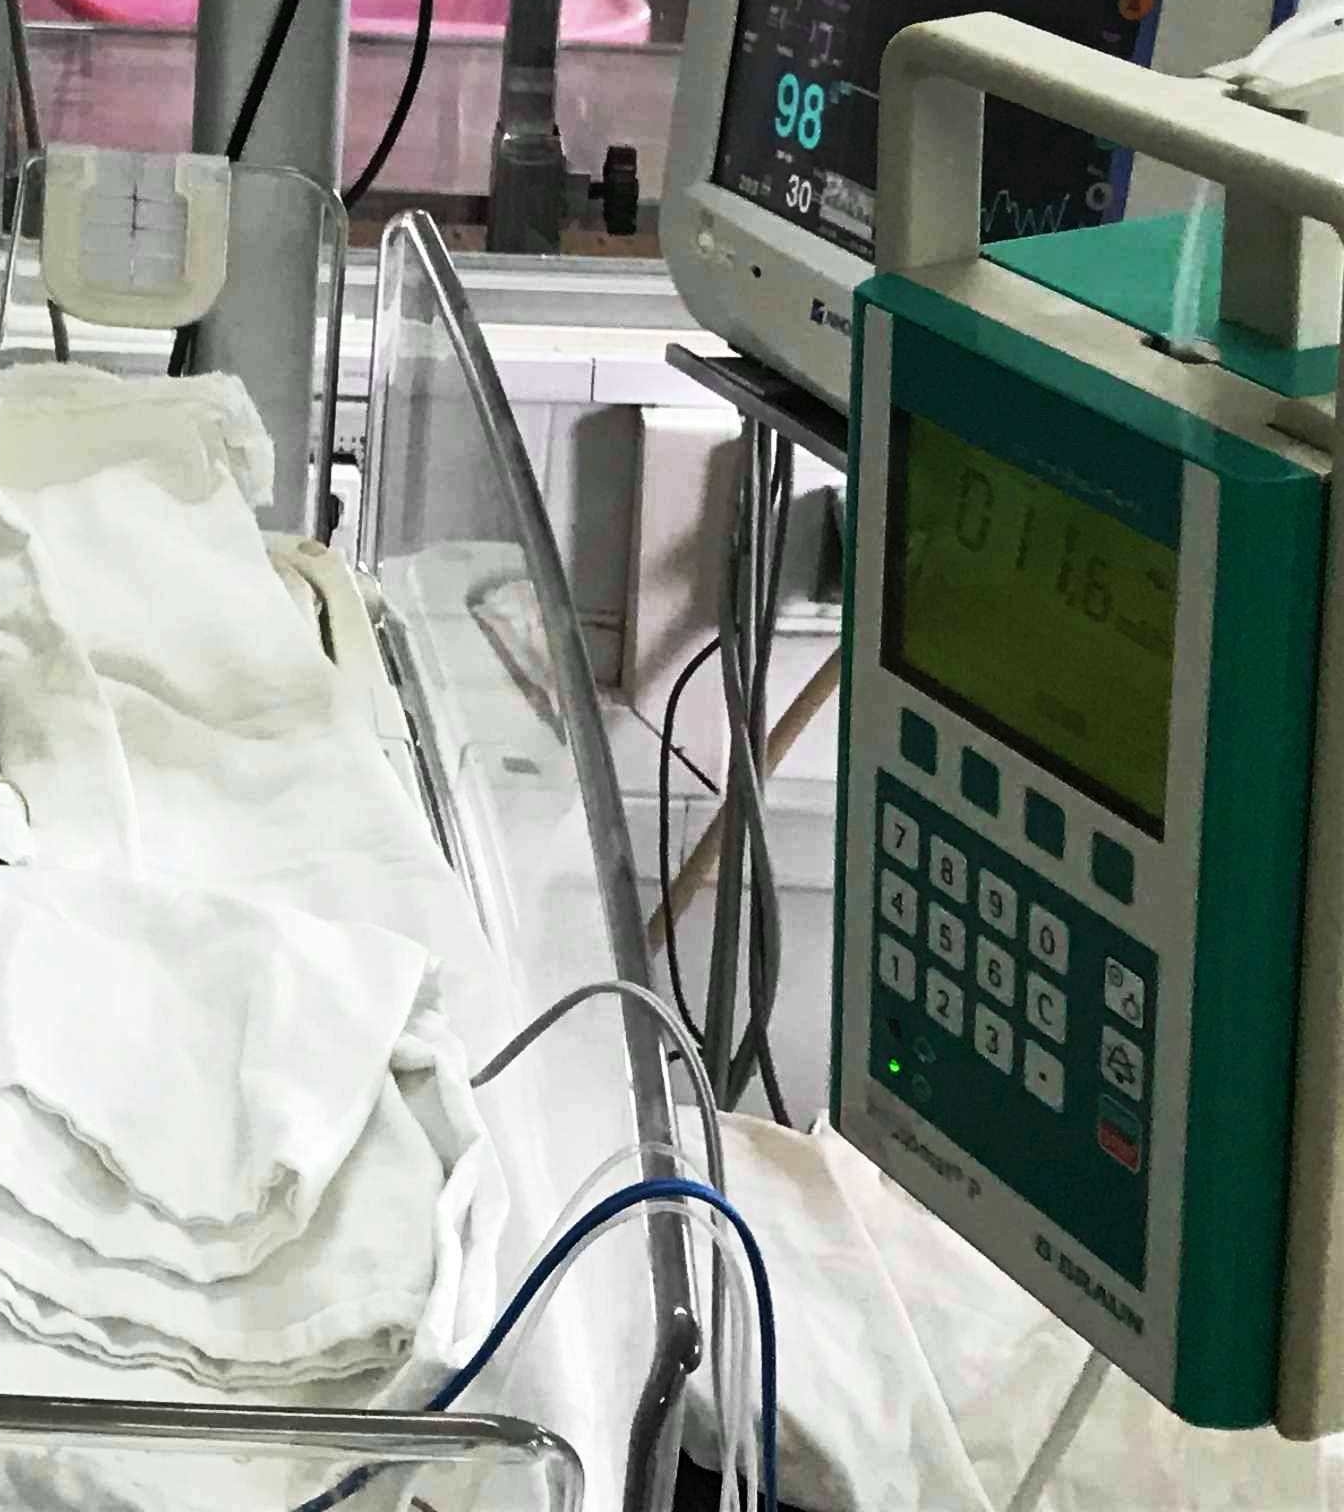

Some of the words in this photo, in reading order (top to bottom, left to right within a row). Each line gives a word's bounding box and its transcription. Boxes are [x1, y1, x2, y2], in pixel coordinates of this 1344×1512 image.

[775, 72, 824, 149] 98
[785, 174, 812, 213] 30
[893, 822, 906, 849] 7
[940, 856, 954, 886] 8
[989, 890, 1003, 919] 9
[1040, 925, 1056, 955] 0
[891, 892, 904, 918] 4
[939, 924, 953, 953] 5
[987, 959, 1002, 988] 6
[1037, 992, 1054, 1025] C
[891, 955, 900, 982] 1
[936, 988, 950, 1019] 2
[985, 1024, 999, 1055] 3
[1059, 1252, 1144, 1335] BRAUN
